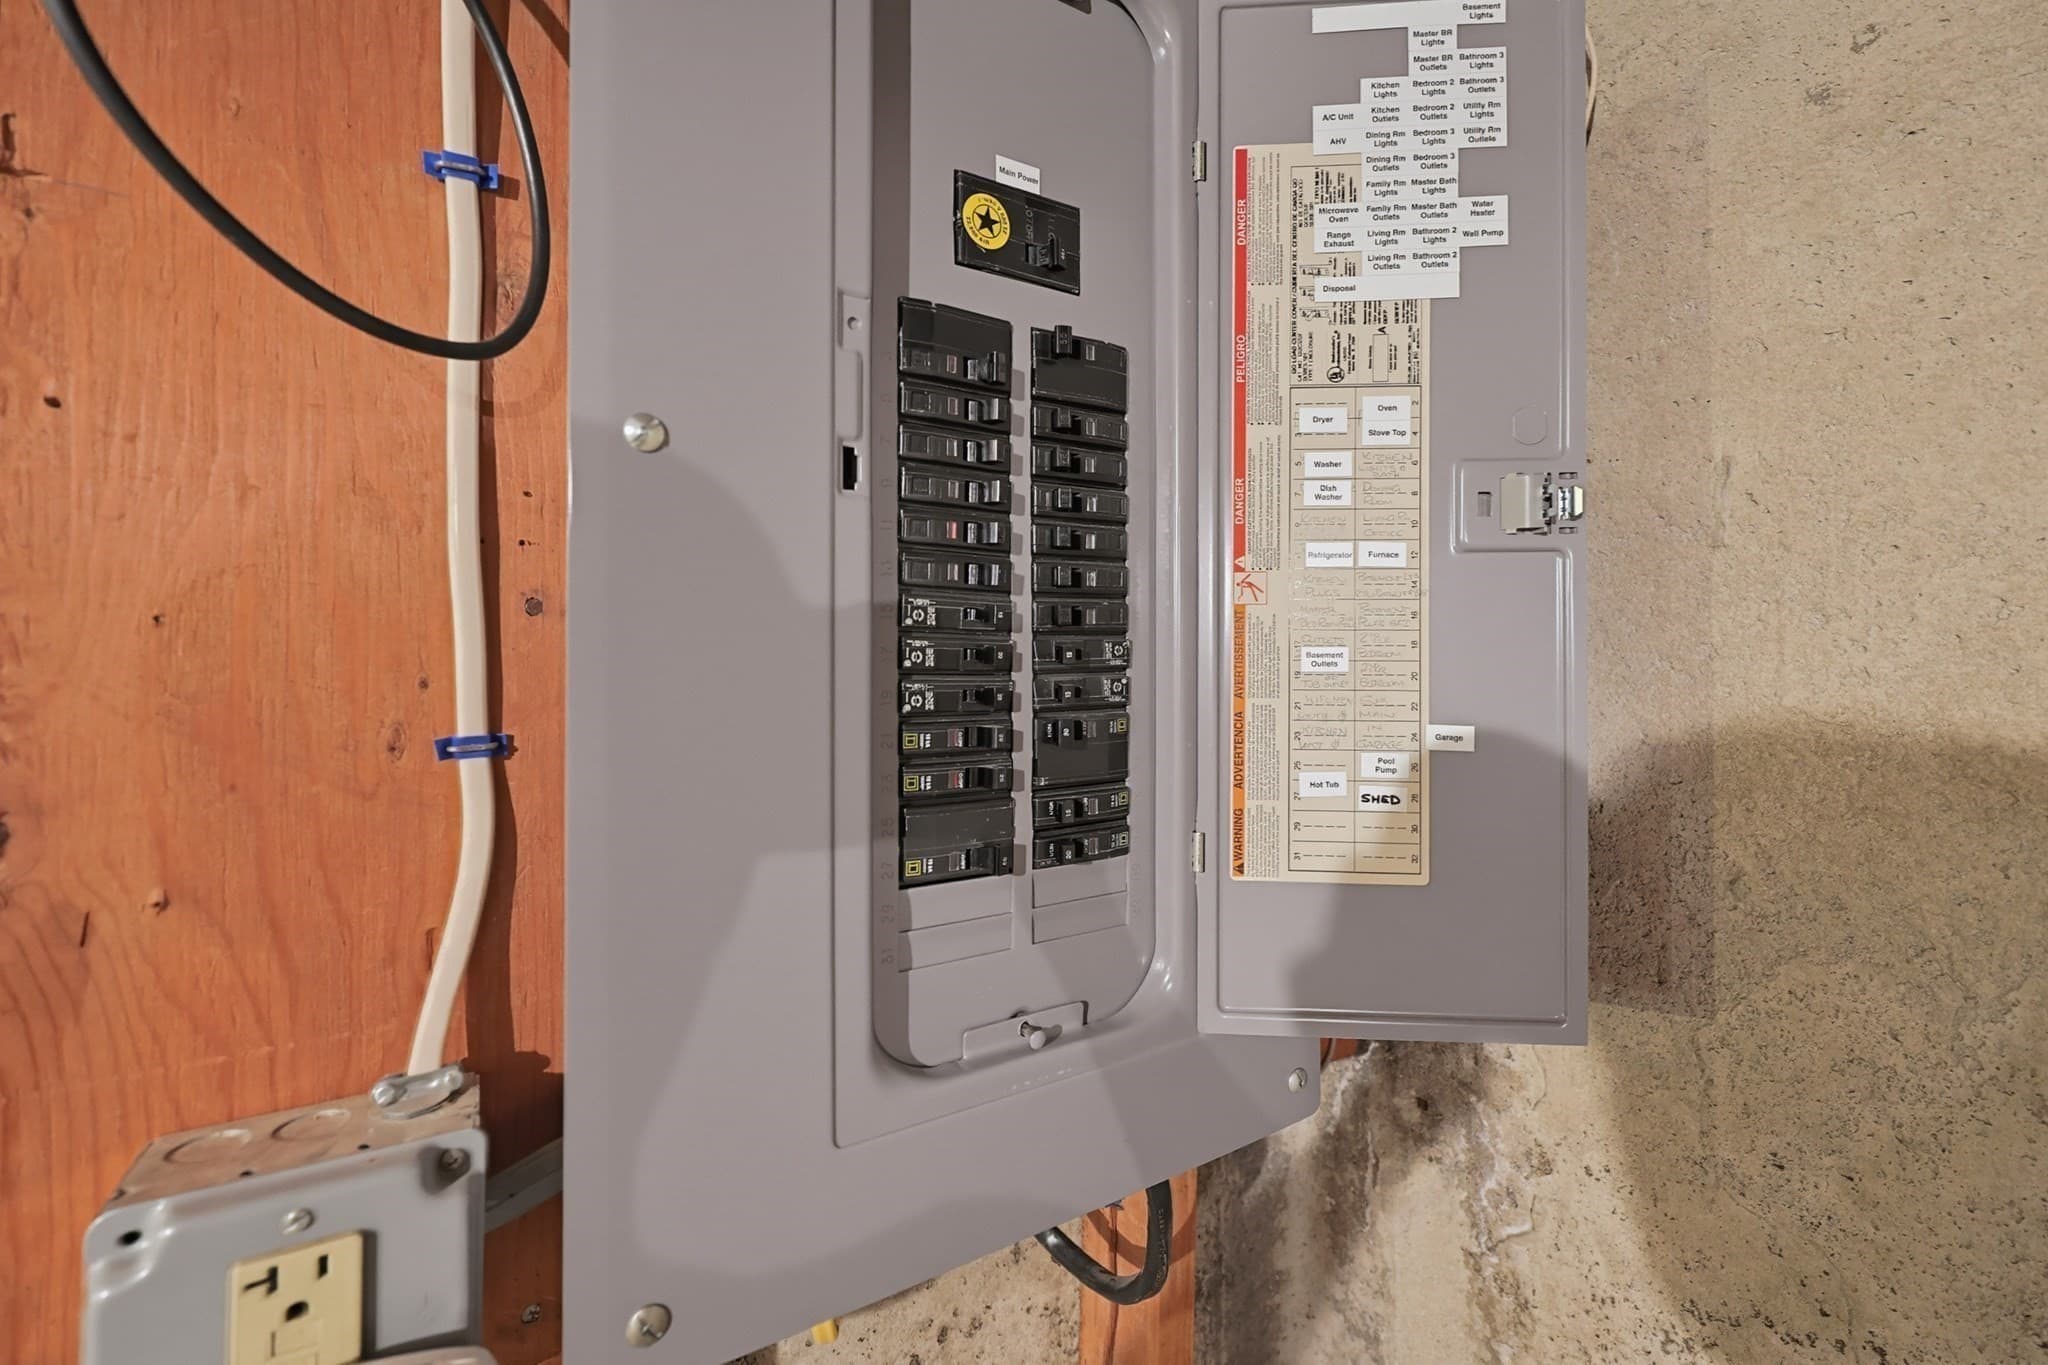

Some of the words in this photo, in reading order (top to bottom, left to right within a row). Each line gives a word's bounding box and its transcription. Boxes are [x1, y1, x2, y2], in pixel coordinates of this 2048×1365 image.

[1421, 38, 1444, 46] Lights
[1374, 90, 1397, 98] Lights
[1470, 110, 1494, 119] Lights
[999, 167, 1016, 178] Main
[1237, 200, 1246, 246] DANGER
[1236, 336, 1246, 383] PELIGRO
[1235, 478, 1244, 524] DANGER
[1308, 552, 1352, 560] Refrigerator
[1234, 610, 1244, 699] AVERTISSEMENT
[1435, 734, 1463, 742] Garage
[1234, 711, 1244, 789] ADVERTENCIA
[1361, 794, 1400, 805] SHED
[1234, 809, 1244, 861] WARNING
